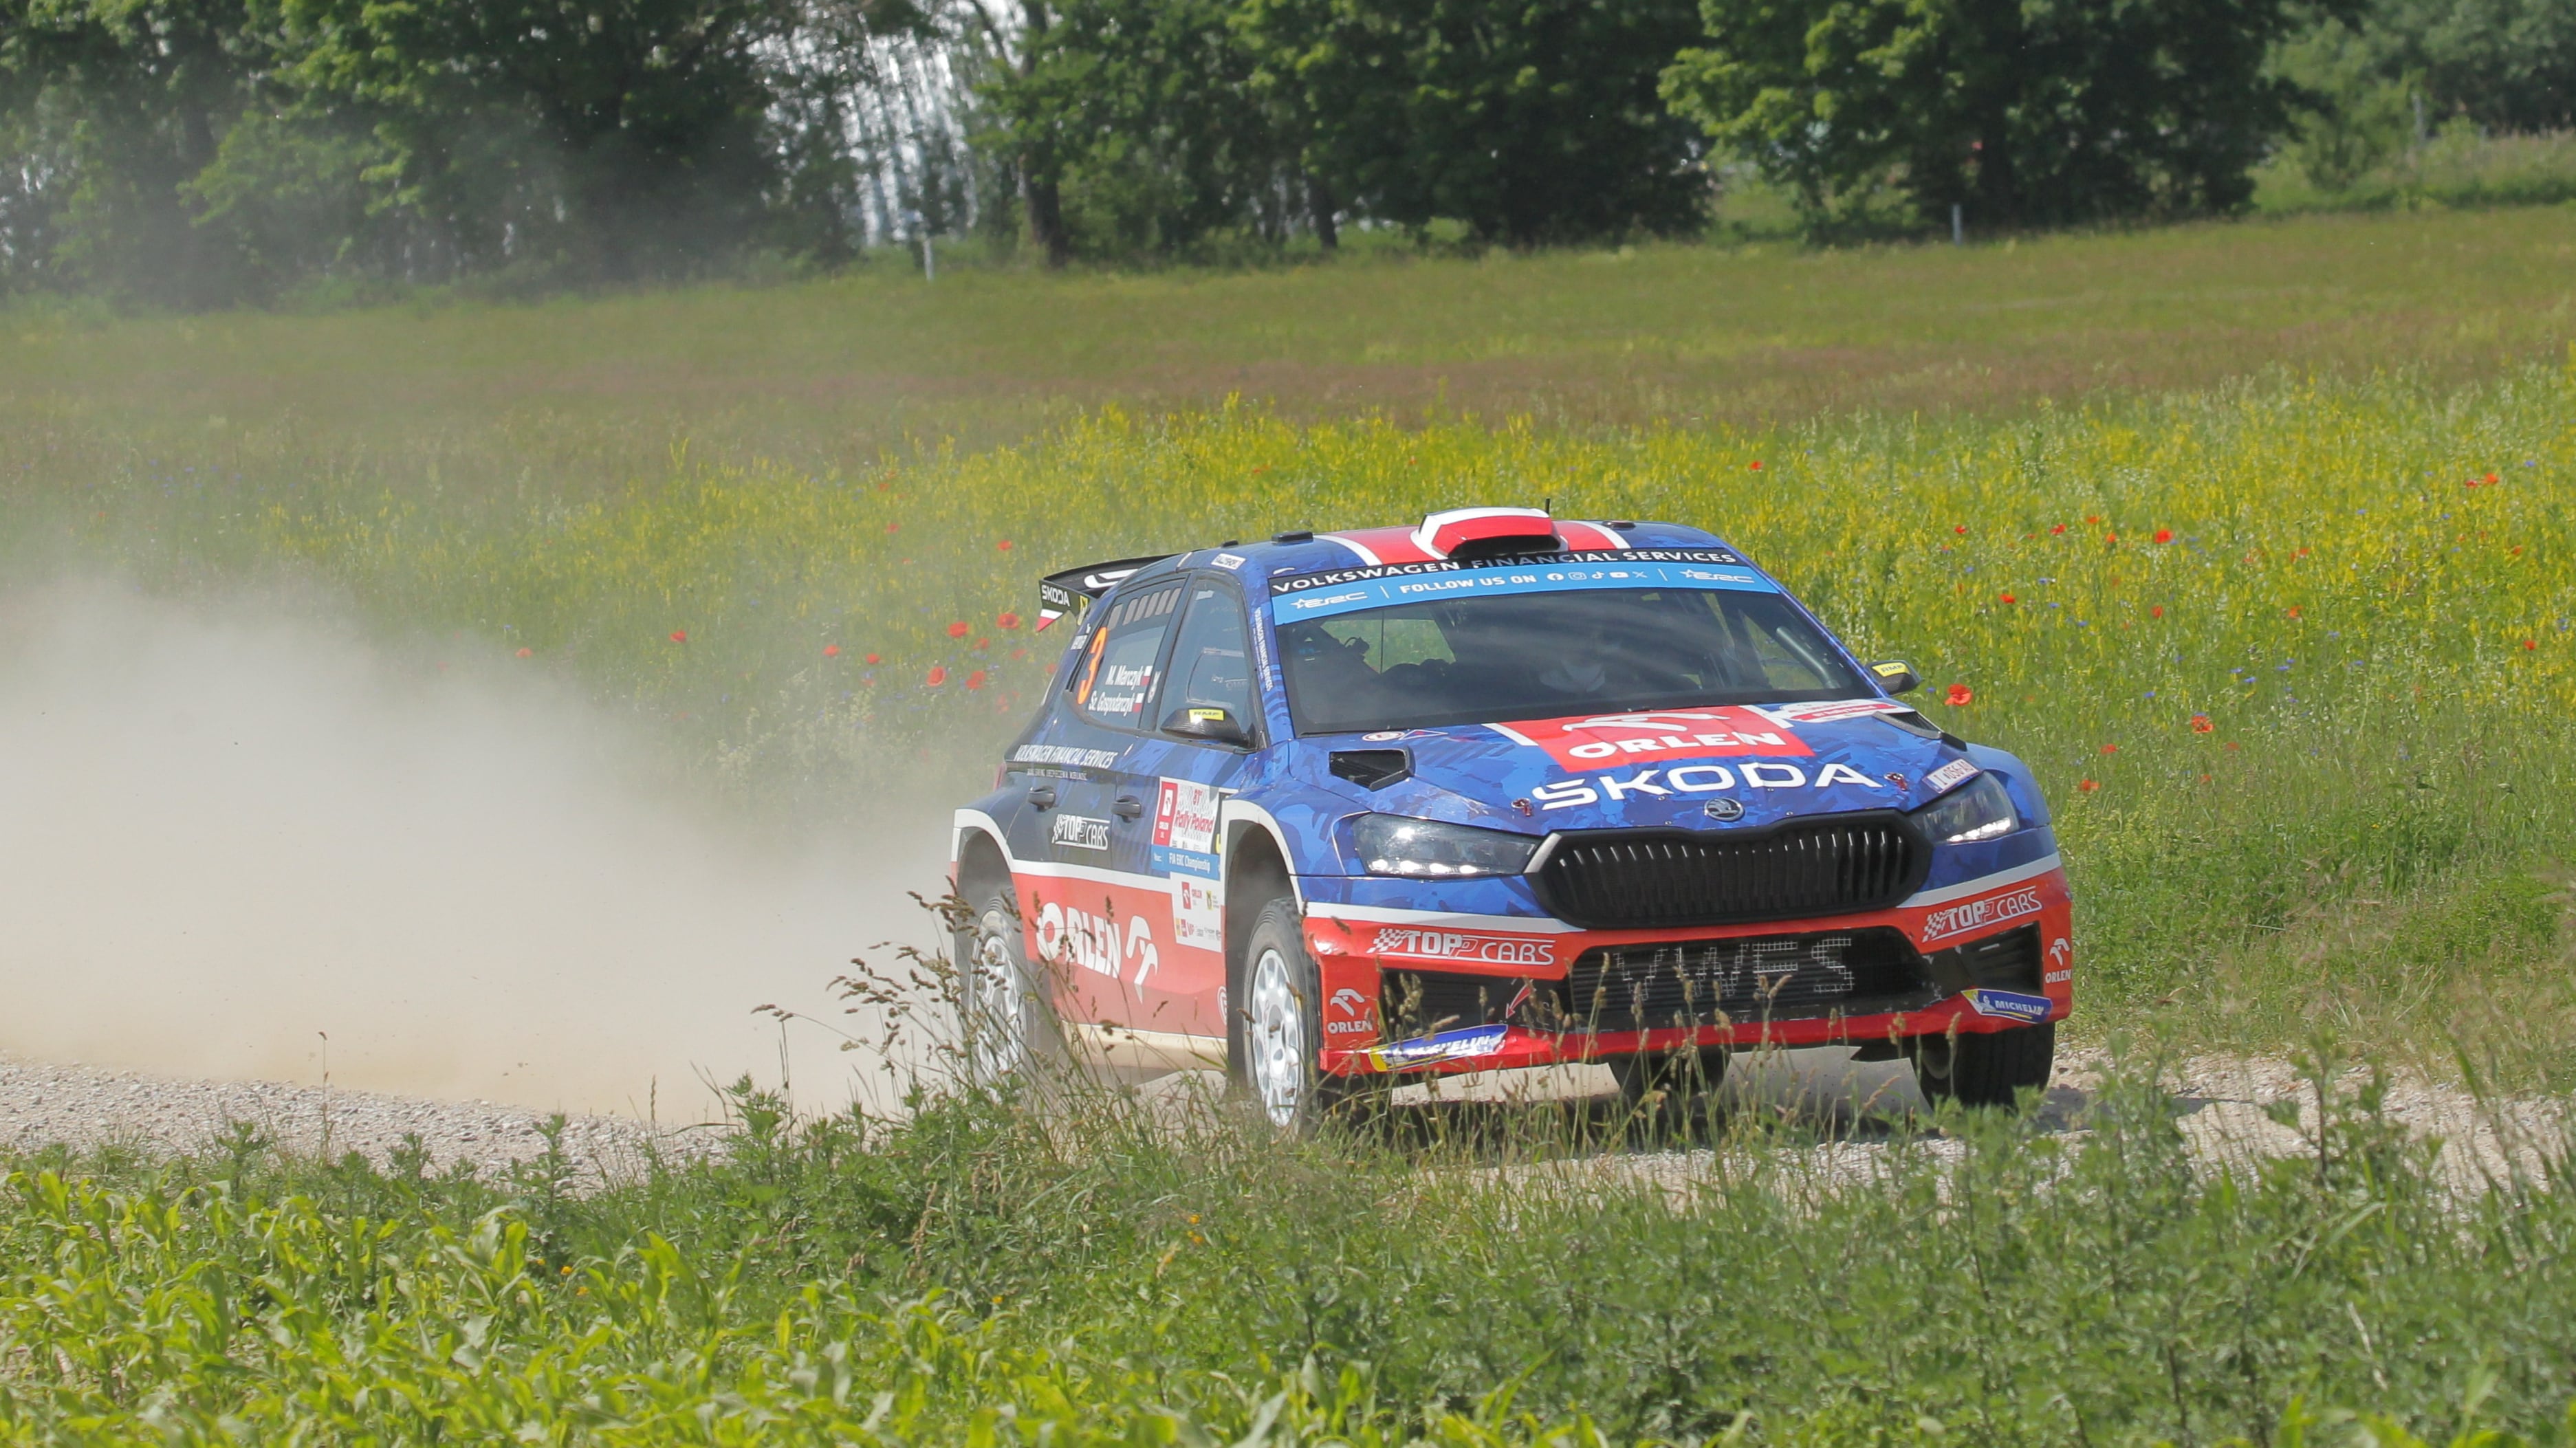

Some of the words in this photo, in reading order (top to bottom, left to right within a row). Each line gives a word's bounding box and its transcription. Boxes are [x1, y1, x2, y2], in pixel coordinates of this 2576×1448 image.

[1272, 561, 1460, 593] VOLKSWAGEN
[1471, 551, 1618, 569] FINANCIAL
[1623, 551, 1736, 563] SERVICES
[1041, 584, 1071, 607] SKODA
[1399, 579, 1475, 594] FOLLOW
[1479, 575, 1505, 586] US
[1510, 574, 1538, 584] ON
[1077, 626, 1108, 705] 3
[1568, 732, 1787, 759] ORLEN
[1079, 749, 1118, 769] SERVICES
[1531, 762, 1884, 811] SKODA
[1086, 824, 1110, 851] CARS
[1996, 890, 2043, 919] CARS
[1036, 902, 1122, 979] ORLEN
[1481, 942, 1555, 965] CARS
[2045, 969, 2072, 984] ORLEN
[1994, 1000, 2044, 1016] MICHELIN
[1327, 1020, 1373, 1034] ORLEN
[1411, 1035, 1491, 1055] ICHELIN
